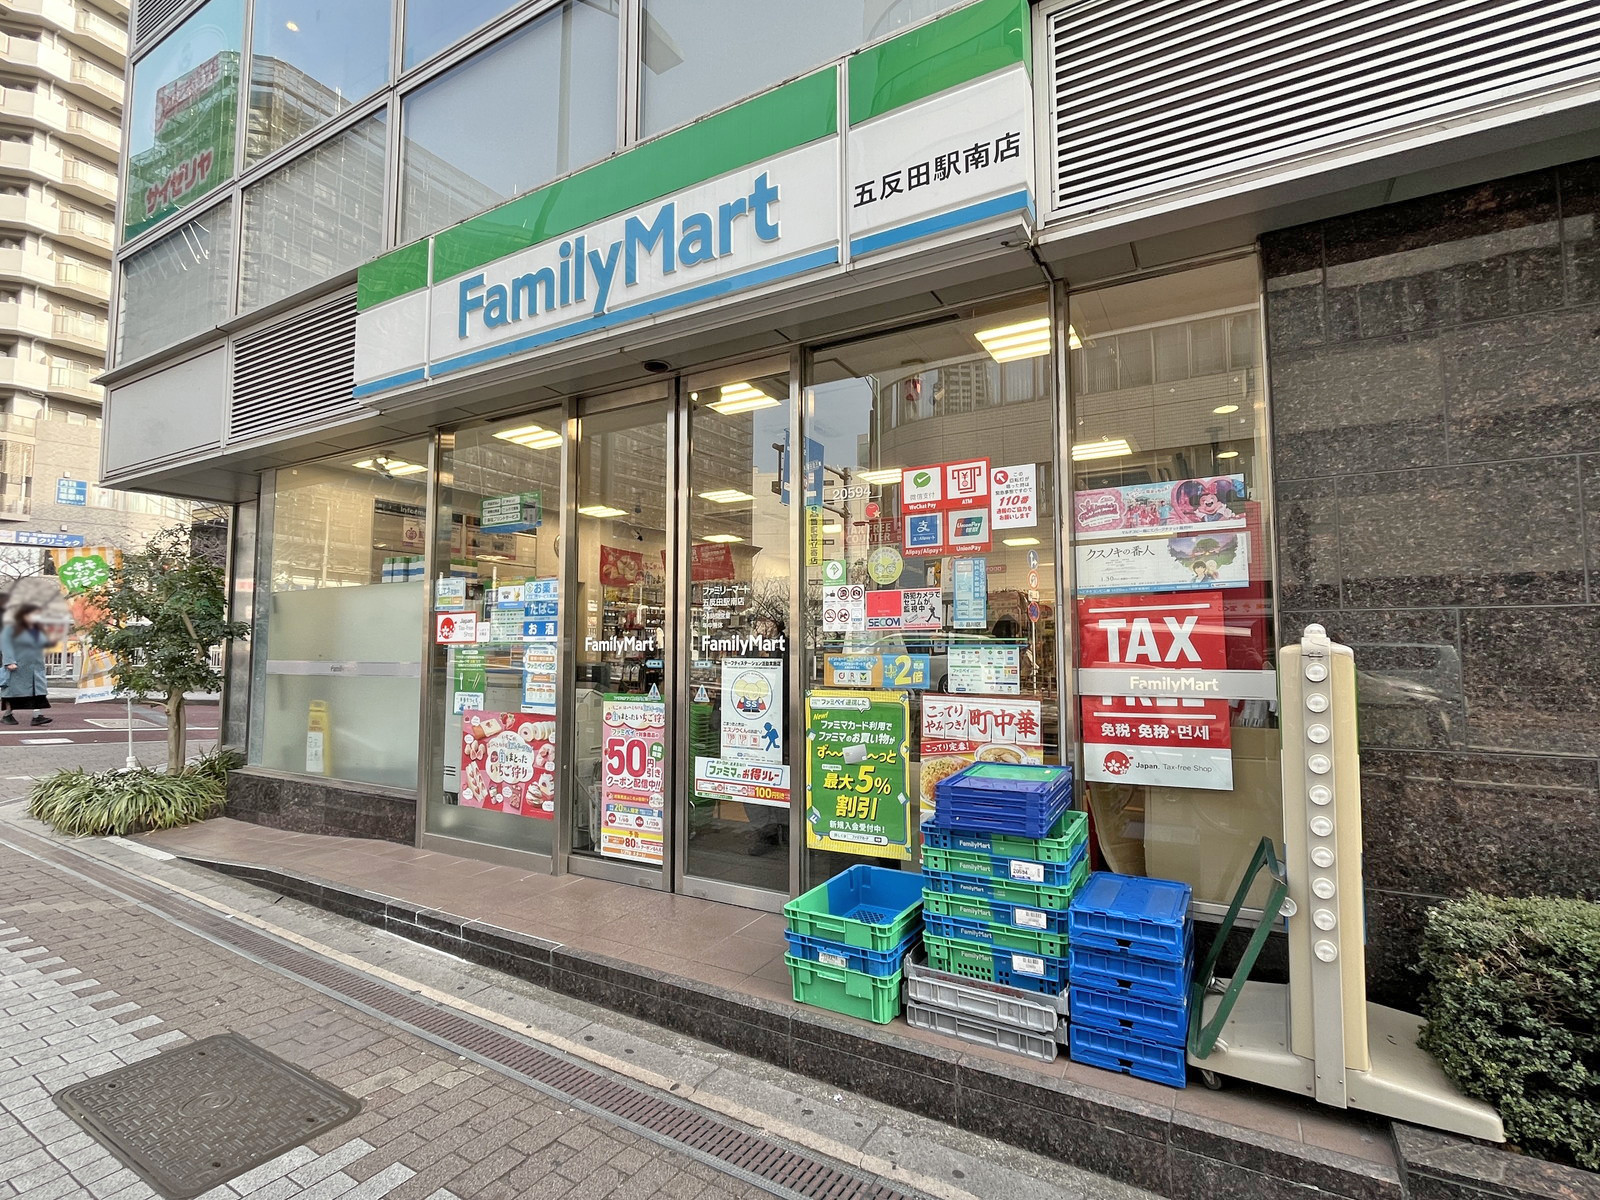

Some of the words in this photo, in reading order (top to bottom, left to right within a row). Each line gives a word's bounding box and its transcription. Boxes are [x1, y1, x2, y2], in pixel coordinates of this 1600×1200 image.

[853, 131, 1022, 209] 五反田駅南店
[146, 147, 214, 215] サイゼリヤ
[458, 170, 781, 339] FamilyMart
[833, 486, 871, 500] 20594
[999, 495, 1029, 506] 110番
[869, 523, 891, 533] FREE
[1086, 545, 1155, 561] クスノキの番人
[534, 583, 551, 594] お薬
[702, 585, 750, 596] ファミリーマート
[904, 591, 941, 599] 防犯カメラで
[703, 597, 744, 606] 五反田駅南店
[531, 602, 555, 615] たばこ
[868, 618, 901, 627] SECOM
[528, 623, 555, 636] お酒
[585, 635, 654, 655] FamilyMart
[702, 635, 786, 656] FamilyMart
[1098, 615, 1203, 663] TAX
[1130, 676, 1219, 692] FamilyMart
[813, 711, 829, 720] New!
[927, 704, 964, 718] こってり
[821, 720, 893, 731] ファミマカード利用で
[925, 719, 967, 733] やみつき!
[969, 708, 1039, 739] 町中華
[818, 731, 896, 745] ファミマのお買い物が
[608, 739, 646, 777] 50
[491, 764, 527, 778] いちご狩り
[709, 765, 780, 782] ファミマのお得リレー
[1136, 762, 1160, 770] Japan.
[1163, 763, 1191, 771] Tax-free
[1193, 764, 1213, 773] Shop
[607, 777, 661, 790] クーポン配信中!!
[835, 795, 878, 821] 割引
[829, 820, 885, 833] 新規入会受付中!
[625, 837, 636, 848] 80
[960, 840, 991, 849] FamilyMart
[960, 862, 991, 872] FamilyMart
[960, 884, 984, 892] FamilyMart
[960, 906, 991, 916] FamilyMart
[960, 928, 992, 939] FamilyMart
[961, 951, 992, 961] FamilyMart
